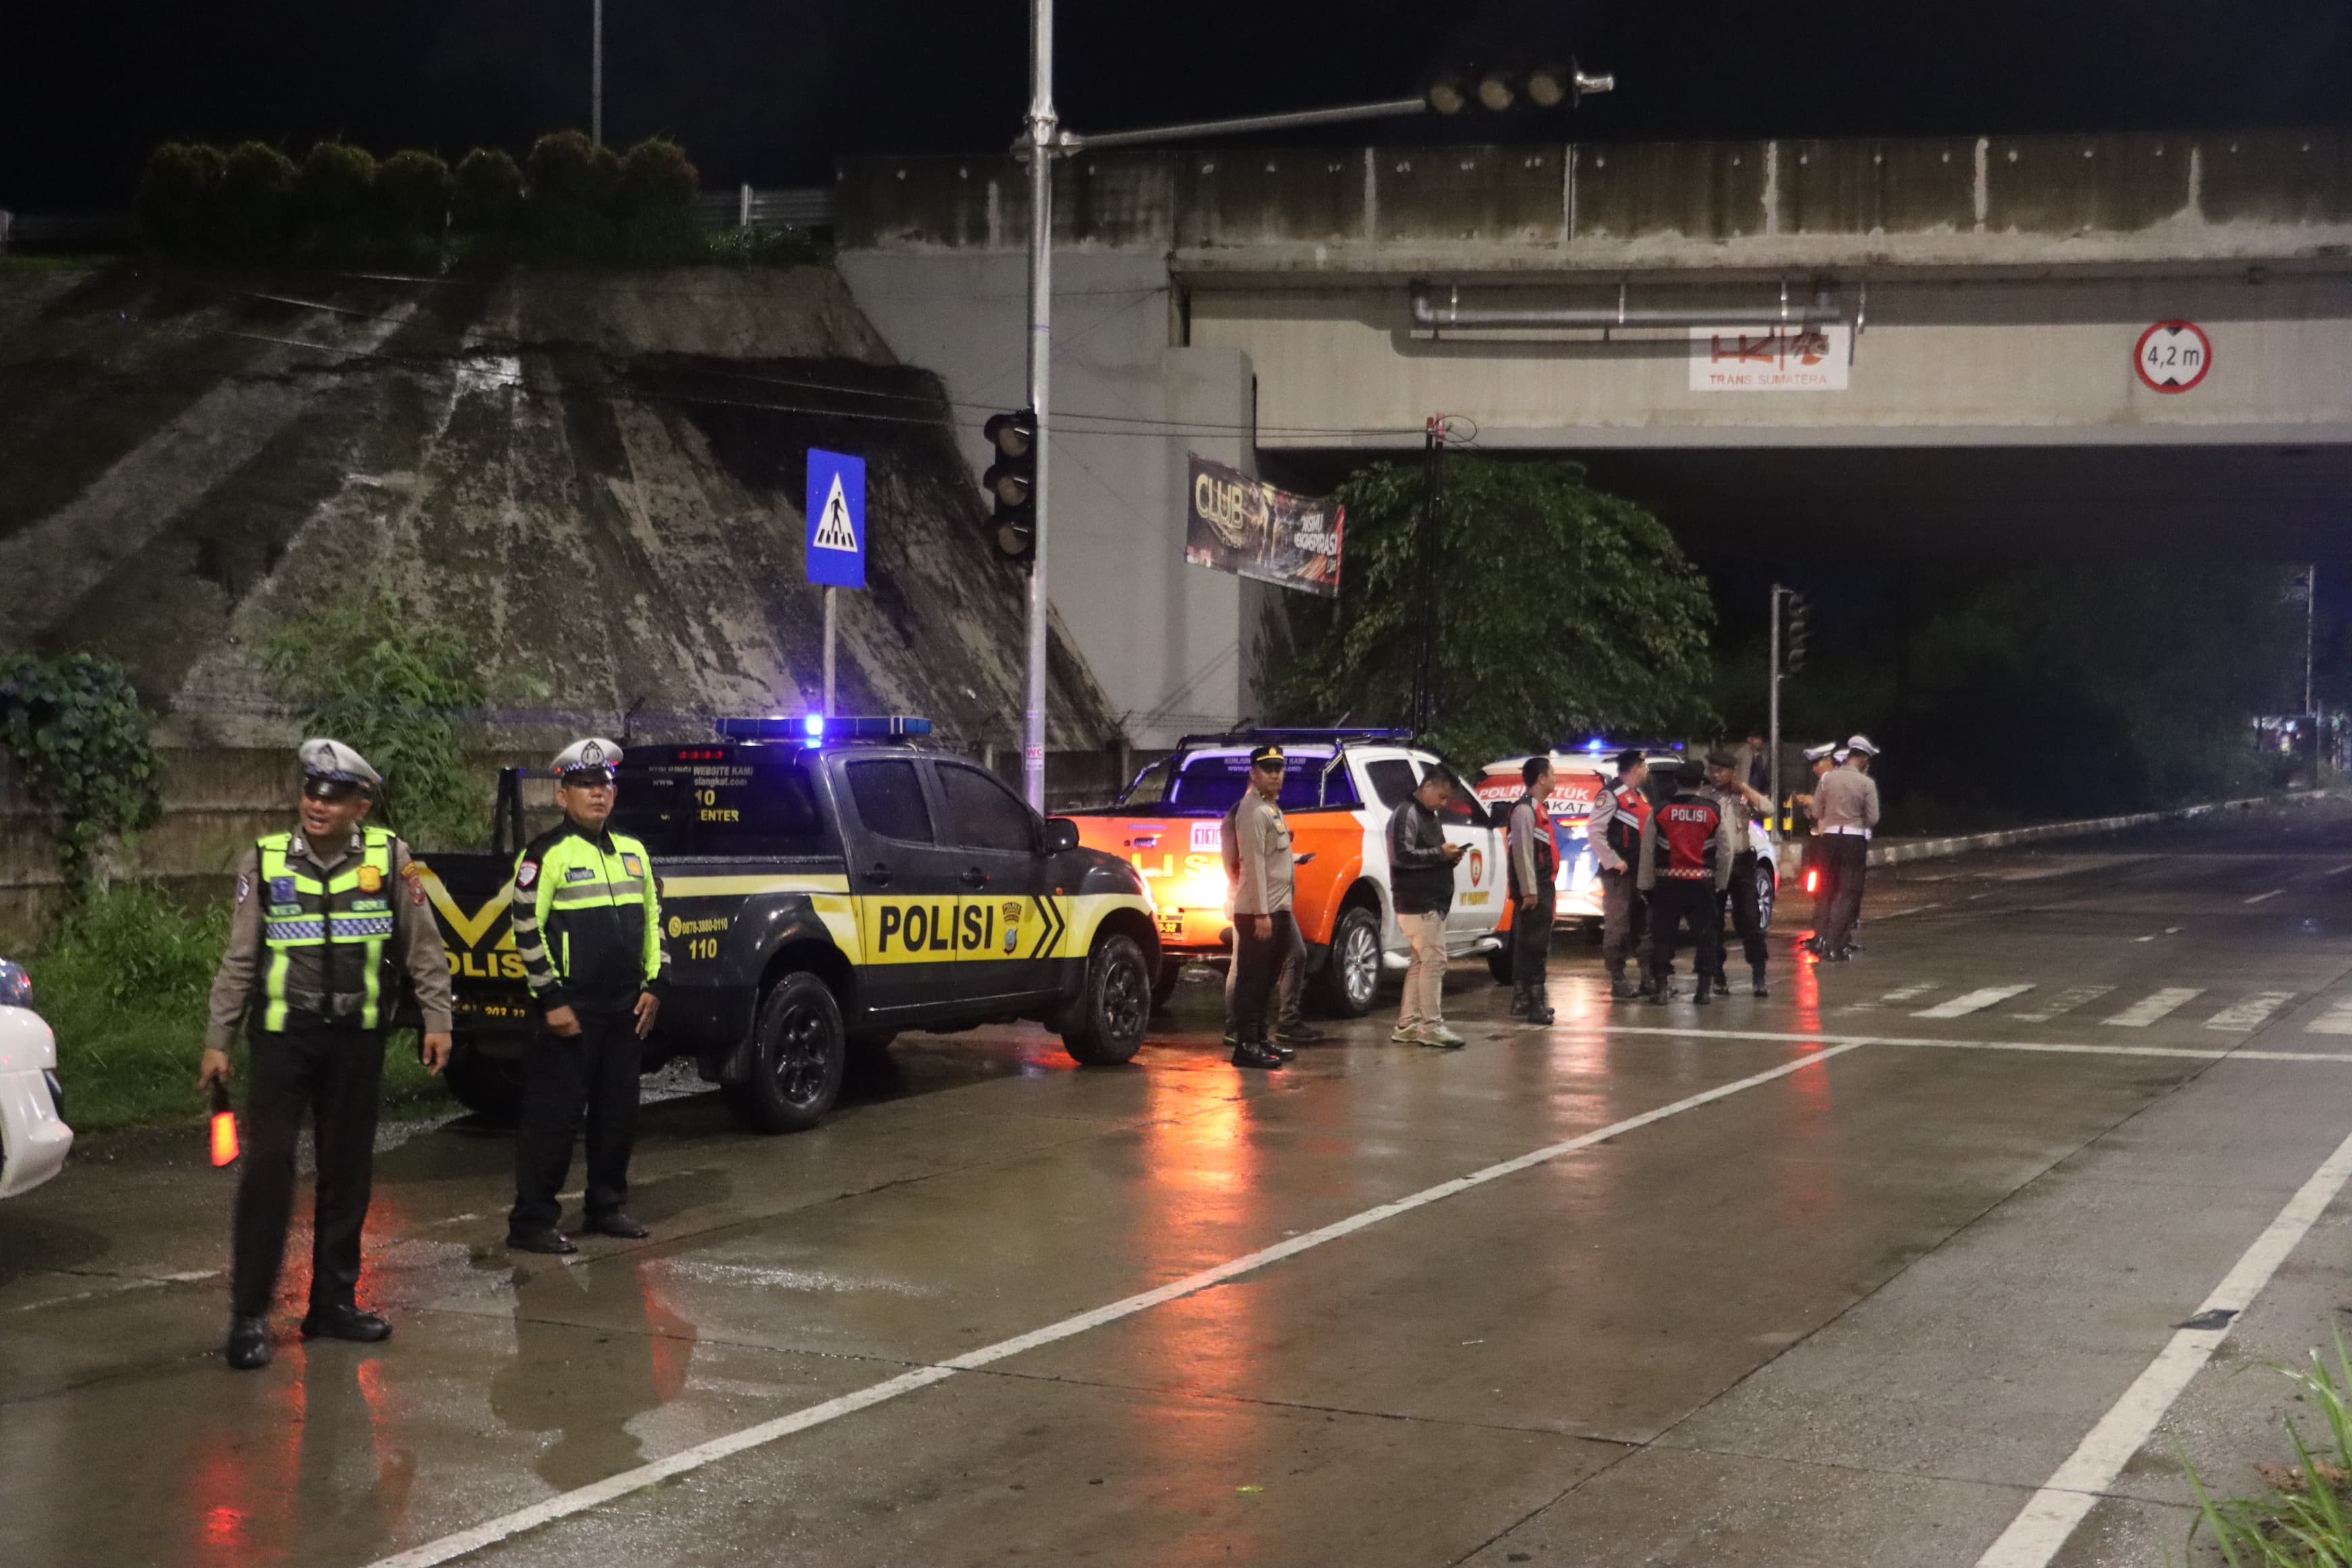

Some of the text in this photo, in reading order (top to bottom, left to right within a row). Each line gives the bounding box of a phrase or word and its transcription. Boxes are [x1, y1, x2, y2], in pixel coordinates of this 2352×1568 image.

[2148, 345, 2199, 369] 4,2 m
[1709, 374, 1827, 385] TRANS SUMATERA
[1196, 474, 1243, 529] CLUB
[1224, 757, 1251, 765] KUNJUN
[693, 766, 730, 777] WEBSITE
[731, 766, 754, 777] KAMI
[694, 789, 716, 806] 10
[1550, 787, 1590, 801] TUK
[699, 809, 739, 822] ENTER
[1671, 808, 1707, 823] POLISI
[879, 904, 994, 952] POLISI
[689, 937, 718, 960] 110
[444, 951, 526, 979] OLIS
